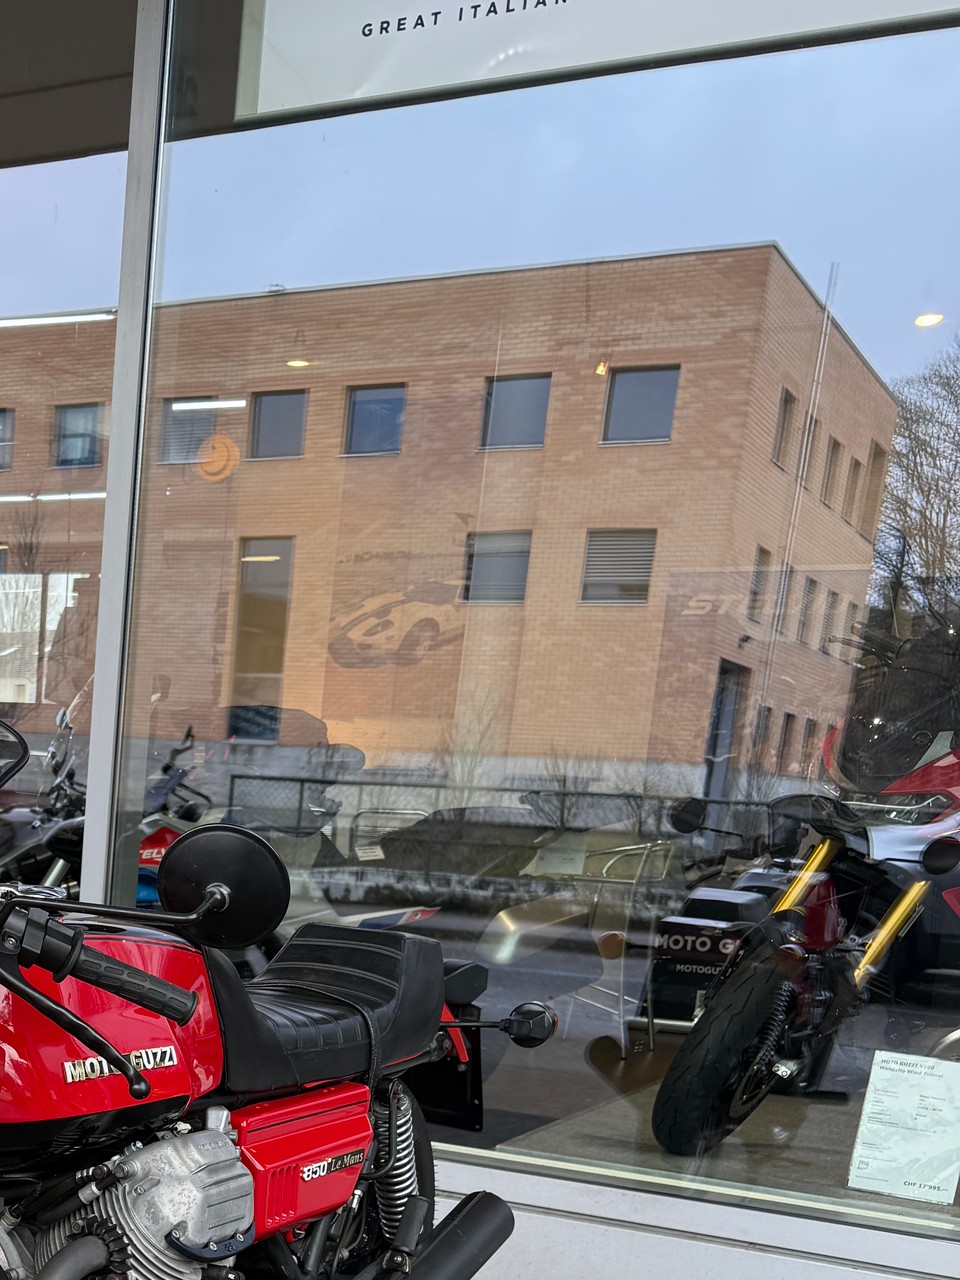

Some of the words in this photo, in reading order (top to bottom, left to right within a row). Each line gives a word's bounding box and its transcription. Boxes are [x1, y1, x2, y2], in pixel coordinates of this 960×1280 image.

[361, 11, 442, 38] GREAT
[458, 0, 567, 21] ITALIA
[654, 934, 712, 952] MOTO
[63, 1055, 122, 1083] MOT
[129, 1045, 179, 1072] GUZZI
[330, 1159, 342, 1172] Le
[342, 1152, 364, 1169] Mans
[903, 1180, 918, 1188] CHF
